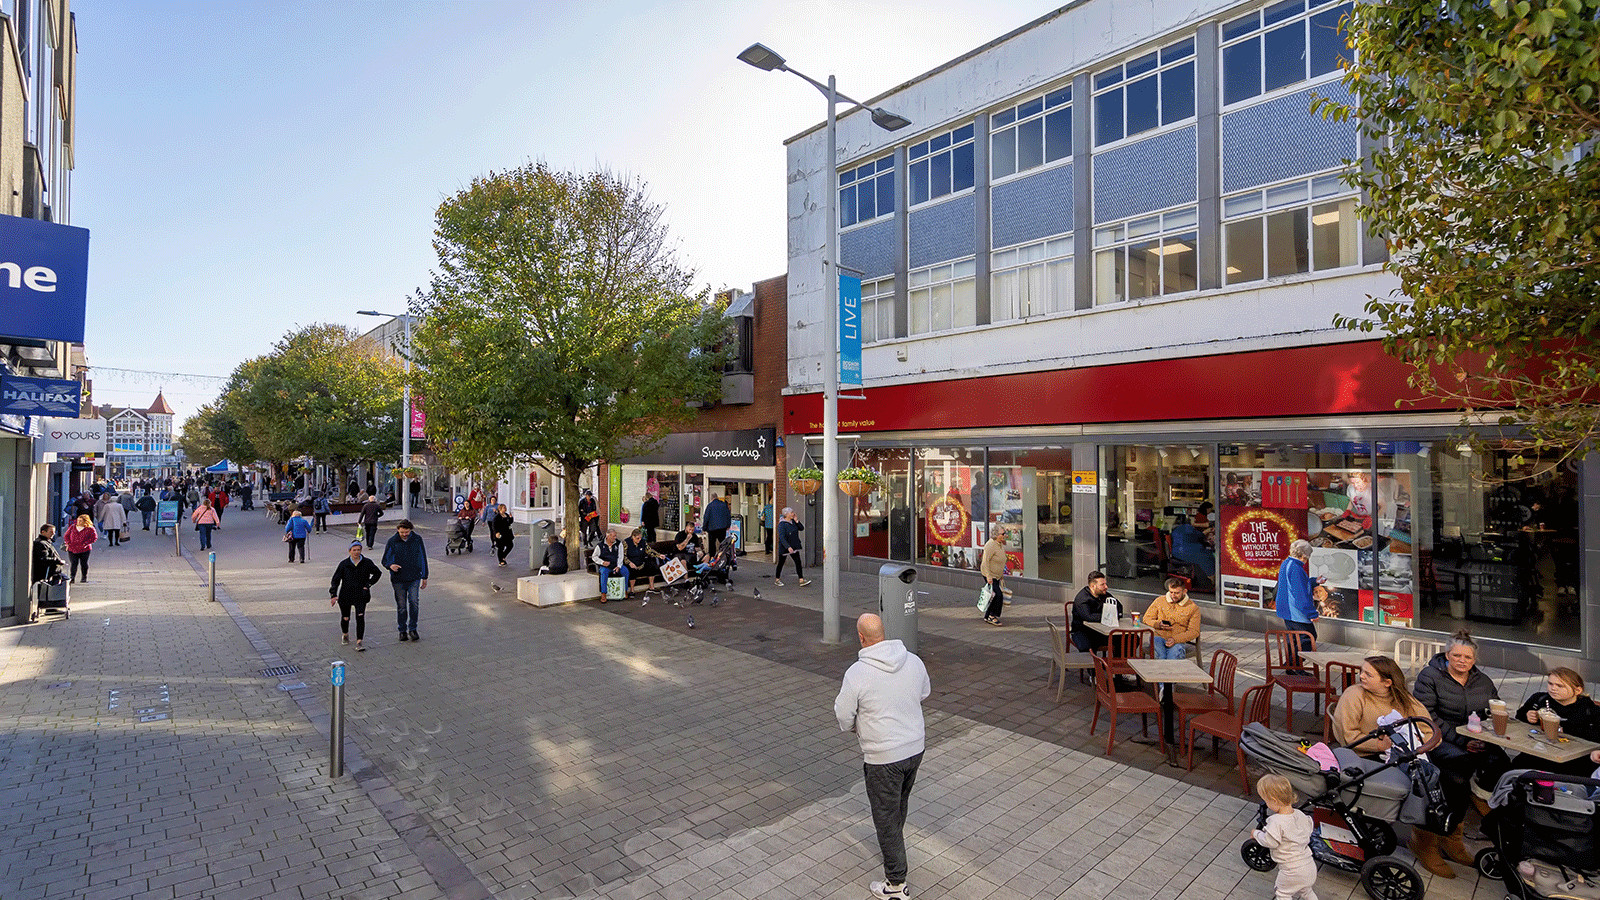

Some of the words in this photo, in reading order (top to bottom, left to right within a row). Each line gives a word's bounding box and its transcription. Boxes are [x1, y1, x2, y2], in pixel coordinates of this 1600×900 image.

[844, 296, 857, 340] LIVE
[3, 390, 77, 404] HALIFAX
[842, 420, 858, 428] family
[859, 419, 875, 427] value
[63, 431, 101, 440] YOURS
[701, 446, 761, 461] Superdrug
[1249, 522, 1268, 533] THE
[1241, 532, 1257, 543] BIG
[1259, 532, 1278, 543] DAY
